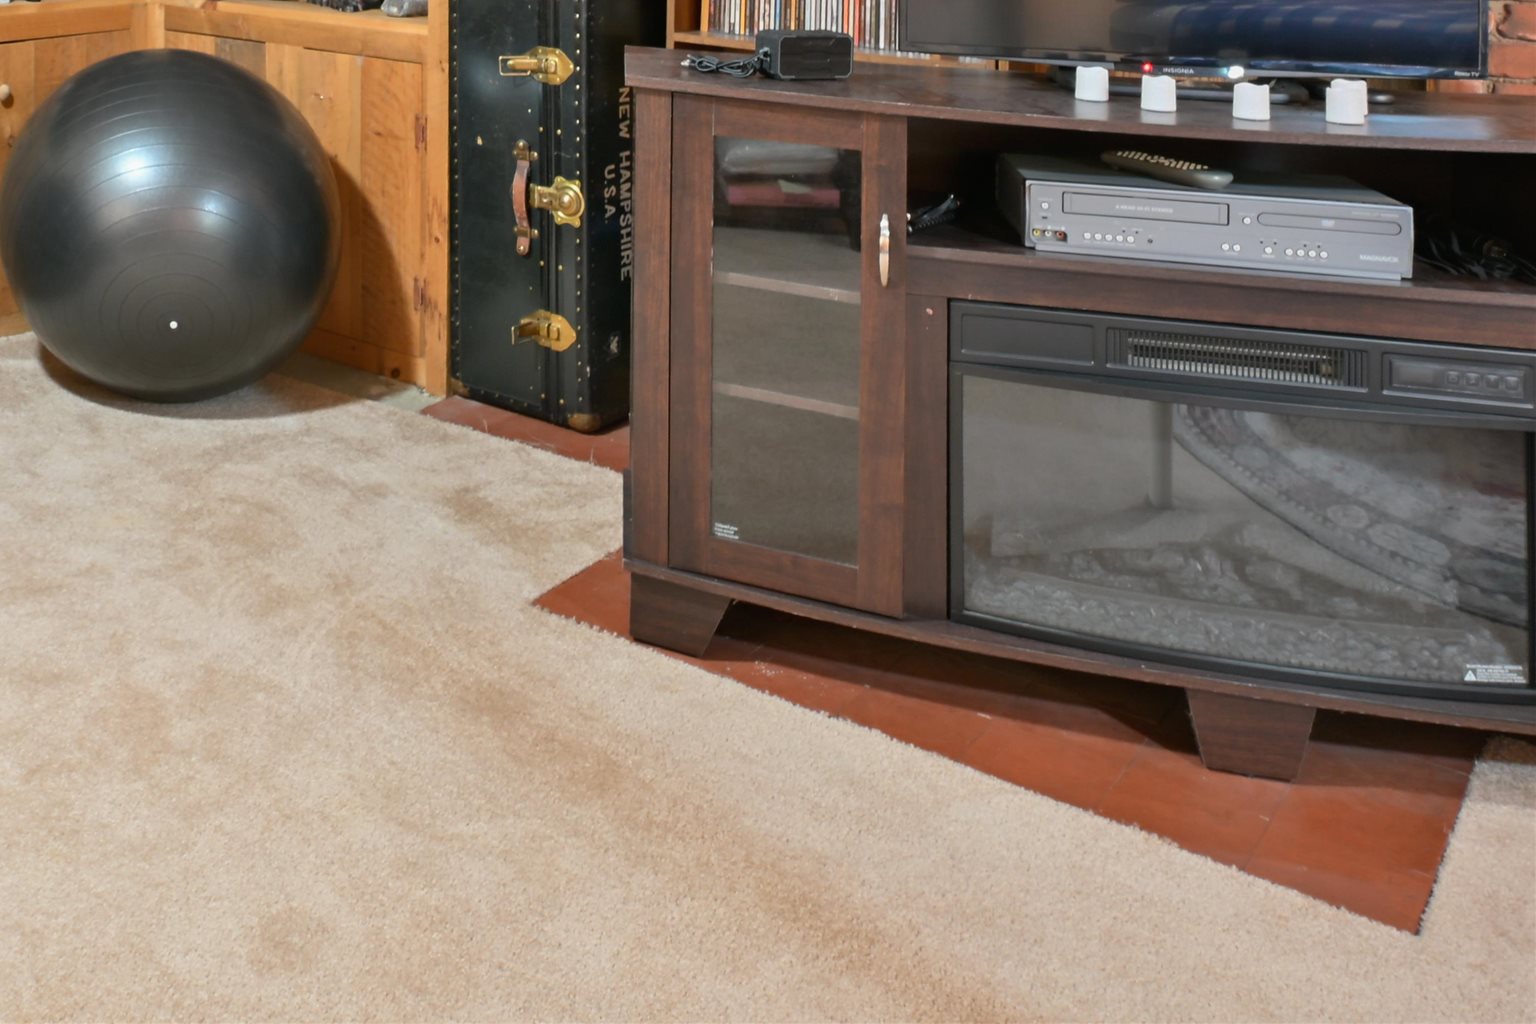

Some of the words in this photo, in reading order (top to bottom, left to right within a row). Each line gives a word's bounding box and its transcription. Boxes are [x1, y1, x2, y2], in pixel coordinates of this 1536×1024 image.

[618, 87, 631, 139] NEW
[604, 164, 616, 224] U.S.A.
[619, 150, 633, 281] HAMPSHIRE
